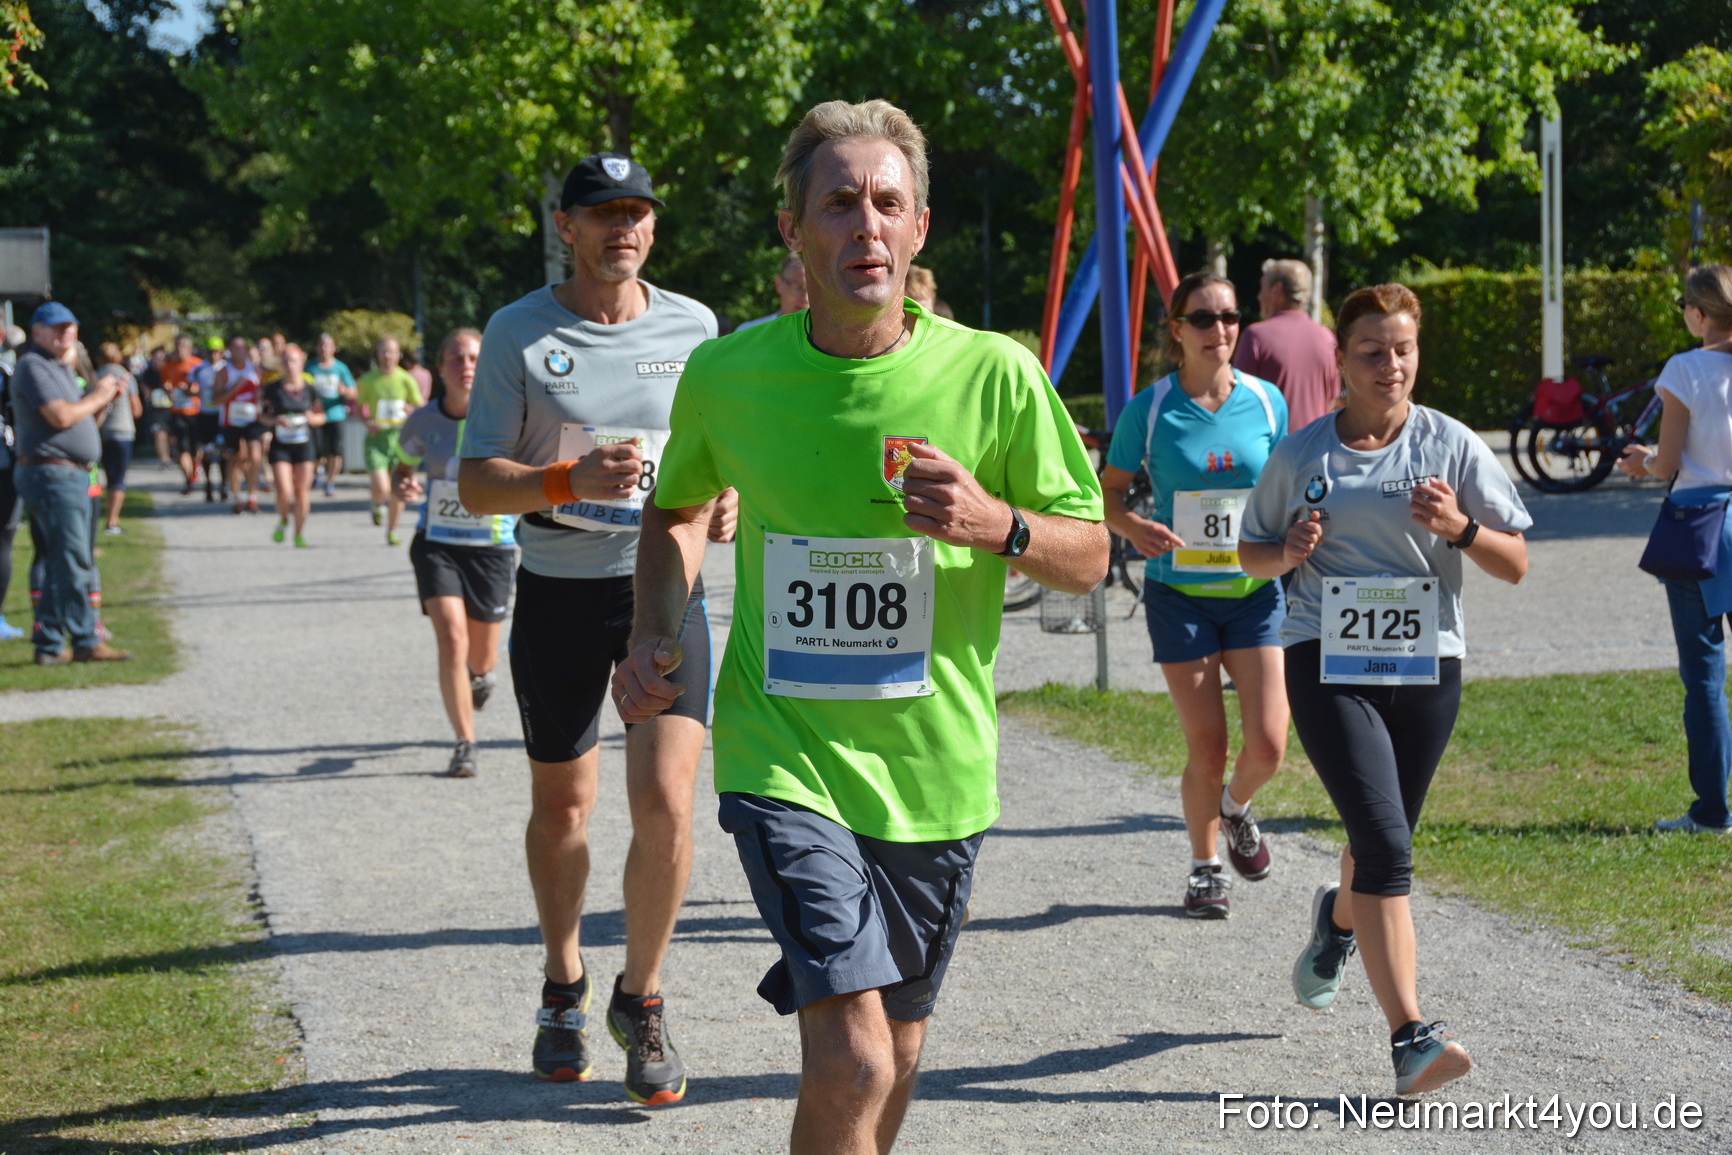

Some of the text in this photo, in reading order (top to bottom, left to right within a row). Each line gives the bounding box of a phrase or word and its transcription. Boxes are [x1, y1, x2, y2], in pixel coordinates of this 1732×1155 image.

[545, 381, 579, 389] PARTL
[1204, 513, 1231, 538] 81
[809, 550, 884, 568] BOCK
[1206, 552, 1231, 564] Julia
[1357, 588, 1408, 600] BOCK
[787, 580, 908, 630] 3108
[772, 615, 778, 624] D
[1340, 608, 1421, 640] 2125
[795, 636, 883, 648] PARTL Neumarkt
[1372, 644, 1406, 652] Neumarkt
[1364, 659, 1397, 673] Jana
